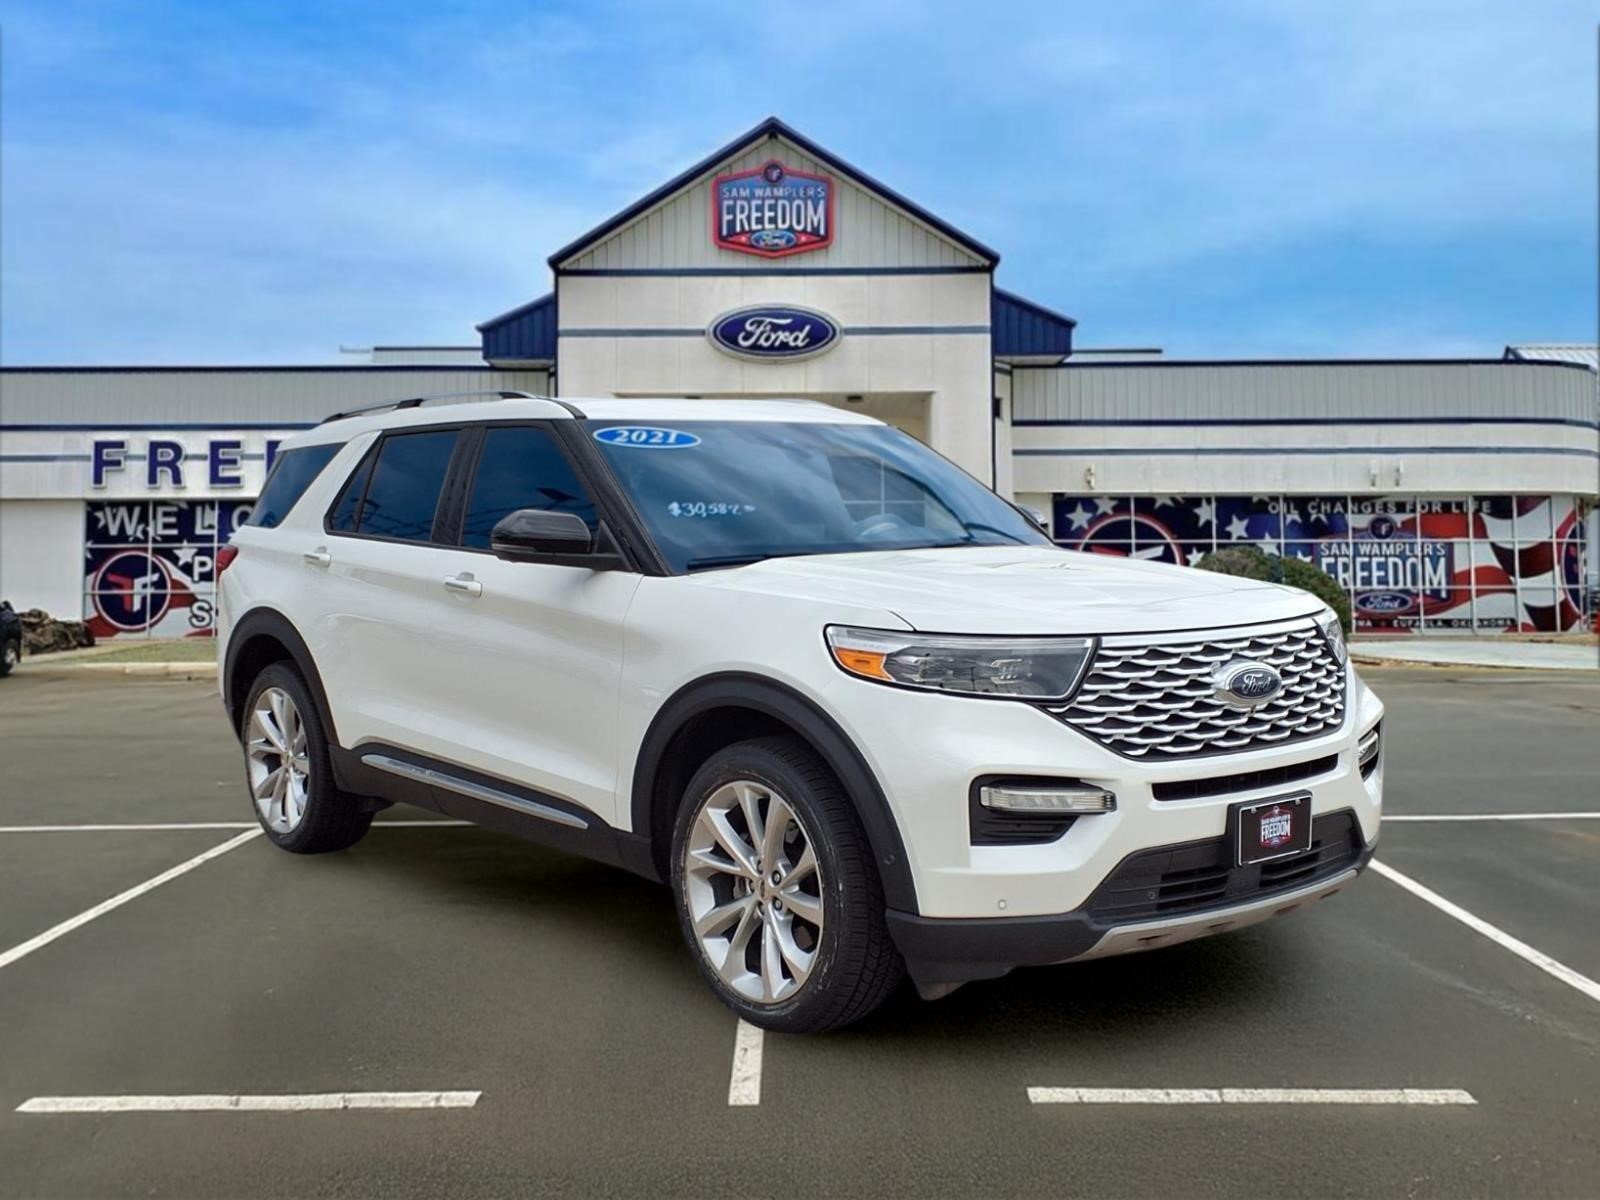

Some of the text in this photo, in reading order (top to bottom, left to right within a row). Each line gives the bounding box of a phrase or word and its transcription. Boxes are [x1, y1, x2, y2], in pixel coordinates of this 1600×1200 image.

[722, 187, 750, 198] SAM
[721, 199, 825, 237] FREEDOM
[737, 317, 812, 348] Ford
[613, 430, 678, 443] 2021
[1267, 501, 1492, 514] OIL CHANGES FOR LIFE
[1365, 595, 1400, 609] Ford
[1242, 673, 1272, 694] Ford
[1261, 820, 1291, 842] FREEDOM
